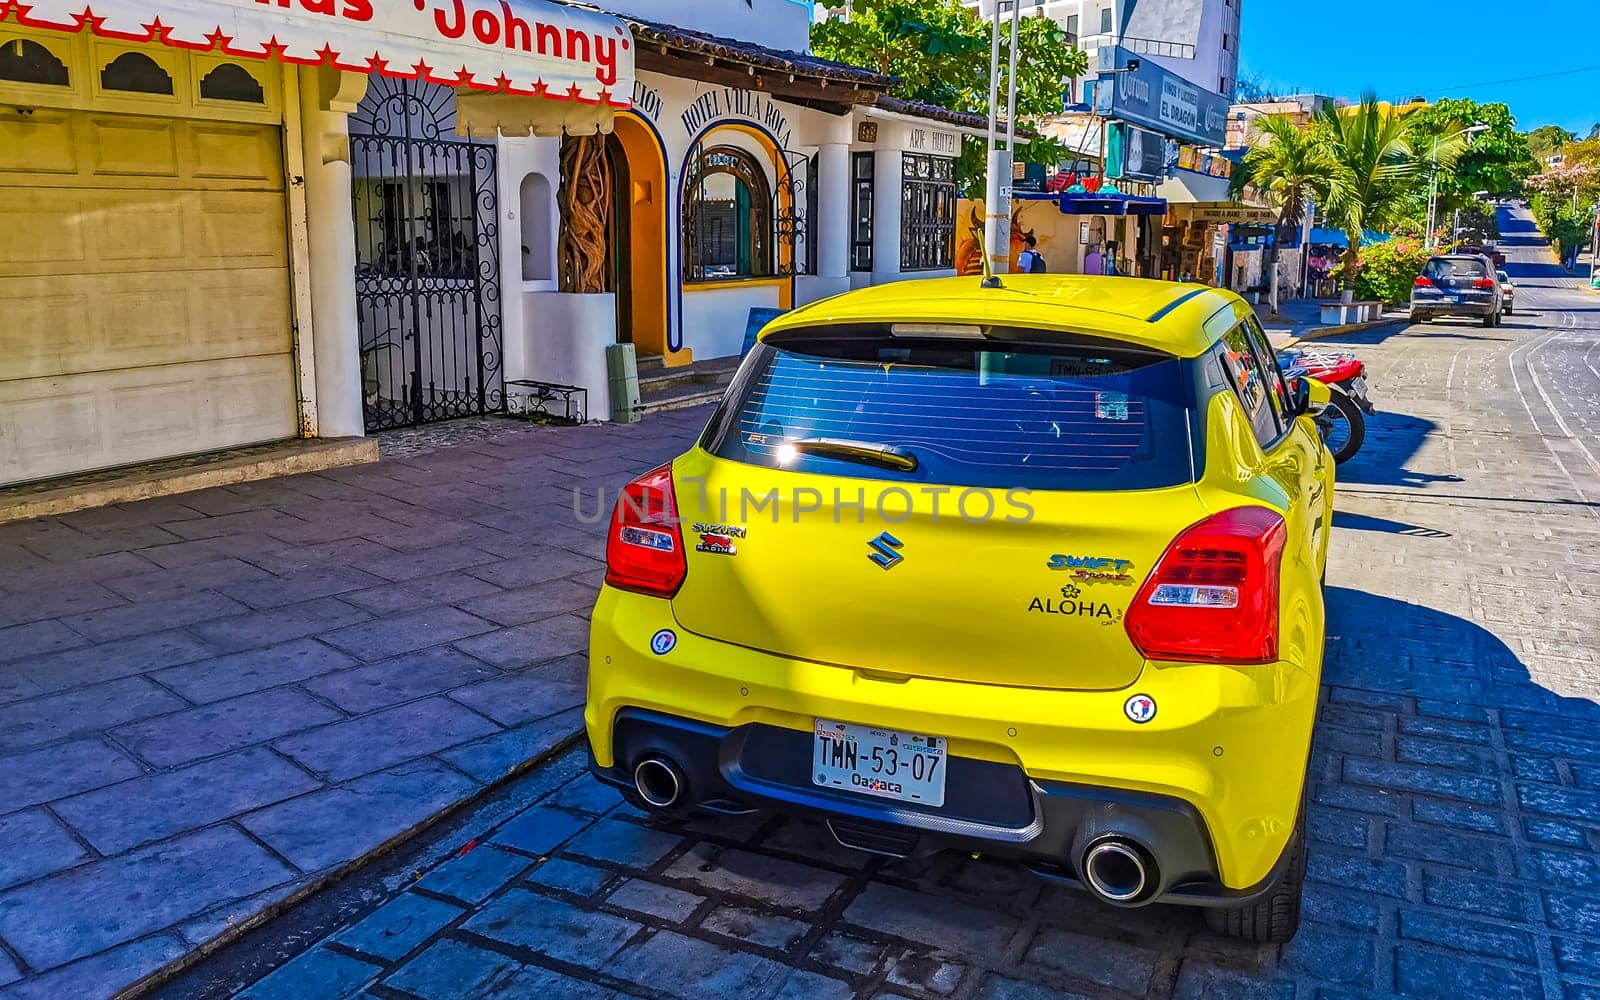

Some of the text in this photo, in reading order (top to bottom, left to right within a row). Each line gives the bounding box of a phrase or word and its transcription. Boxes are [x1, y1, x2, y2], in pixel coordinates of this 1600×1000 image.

[632, 80, 664, 122] CIÓN
[1161, 100, 1170, 117] EL
[681, 87, 792, 150] HOTEL VILLA ROCA
[692, 522, 747, 539] SUZUKI
[1047, 553, 1131, 570] SWIFT
[1028, 597, 1112, 618] ALOHA
[819, 736, 940, 782] TMN-53-07
[851, 773, 902, 793] Oaxaca
